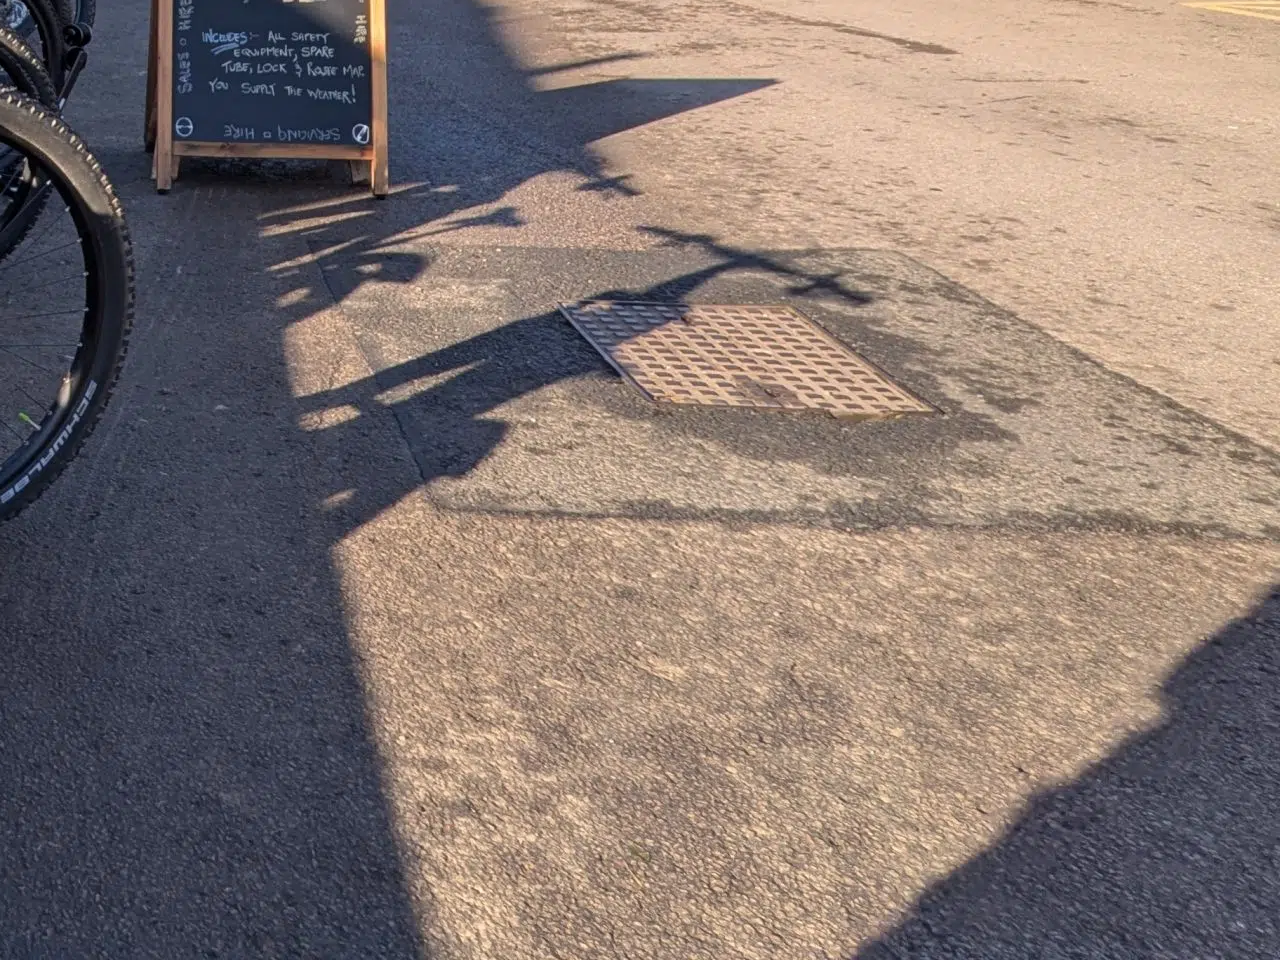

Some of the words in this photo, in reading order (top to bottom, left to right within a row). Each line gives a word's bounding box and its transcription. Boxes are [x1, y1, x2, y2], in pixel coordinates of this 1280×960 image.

[178, 0, 195, 31] HIRE
[268, 30, 286, 43] ALL
[291, 31, 330, 45] SAFETY
[301, 46, 335, 59] SPARE
[178, 51, 193, 94] SALES
[257, 63, 287, 74] LOCK
[209, 77, 229, 93] YOU
[284, 85, 303, 97] THE
[0, 379, 98, 504] SCHWALBE
